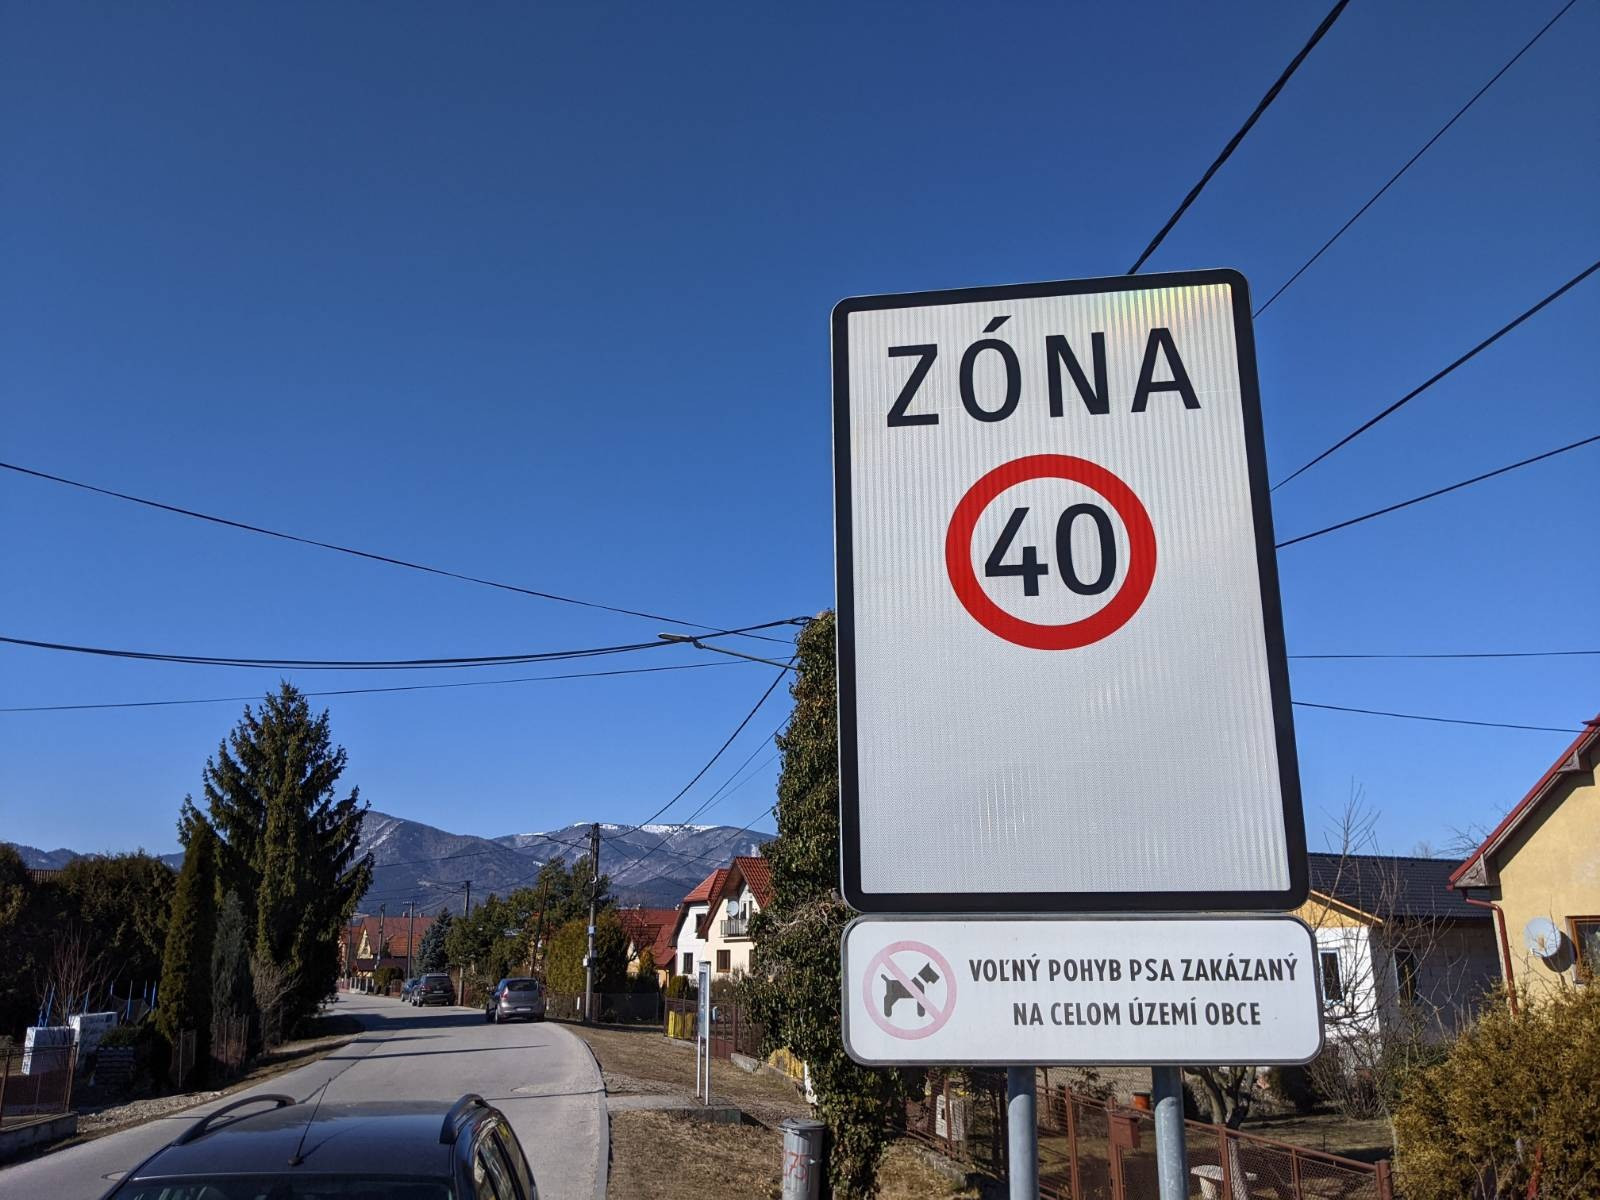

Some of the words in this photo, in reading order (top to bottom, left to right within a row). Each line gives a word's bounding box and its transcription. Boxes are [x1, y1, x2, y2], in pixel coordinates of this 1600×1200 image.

[887, 315, 1202, 428] ZÓNA
[985, 503, 1117, 597] 40
[969, 953, 1041, 982] VOĽNÝ
[1049, 959, 1122, 982] POHYB
[1130, 958, 1175, 982] PSA
[1181, 952, 1298, 982] ZAKÁZANÝ
[1014, 1003, 1044, 1026] NA
[1051, 1002, 1121, 1026] CELOM
[1129, 996, 1197, 1026] ÚZEMÍ
[1206, 1002, 1261, 1026] OBCE
